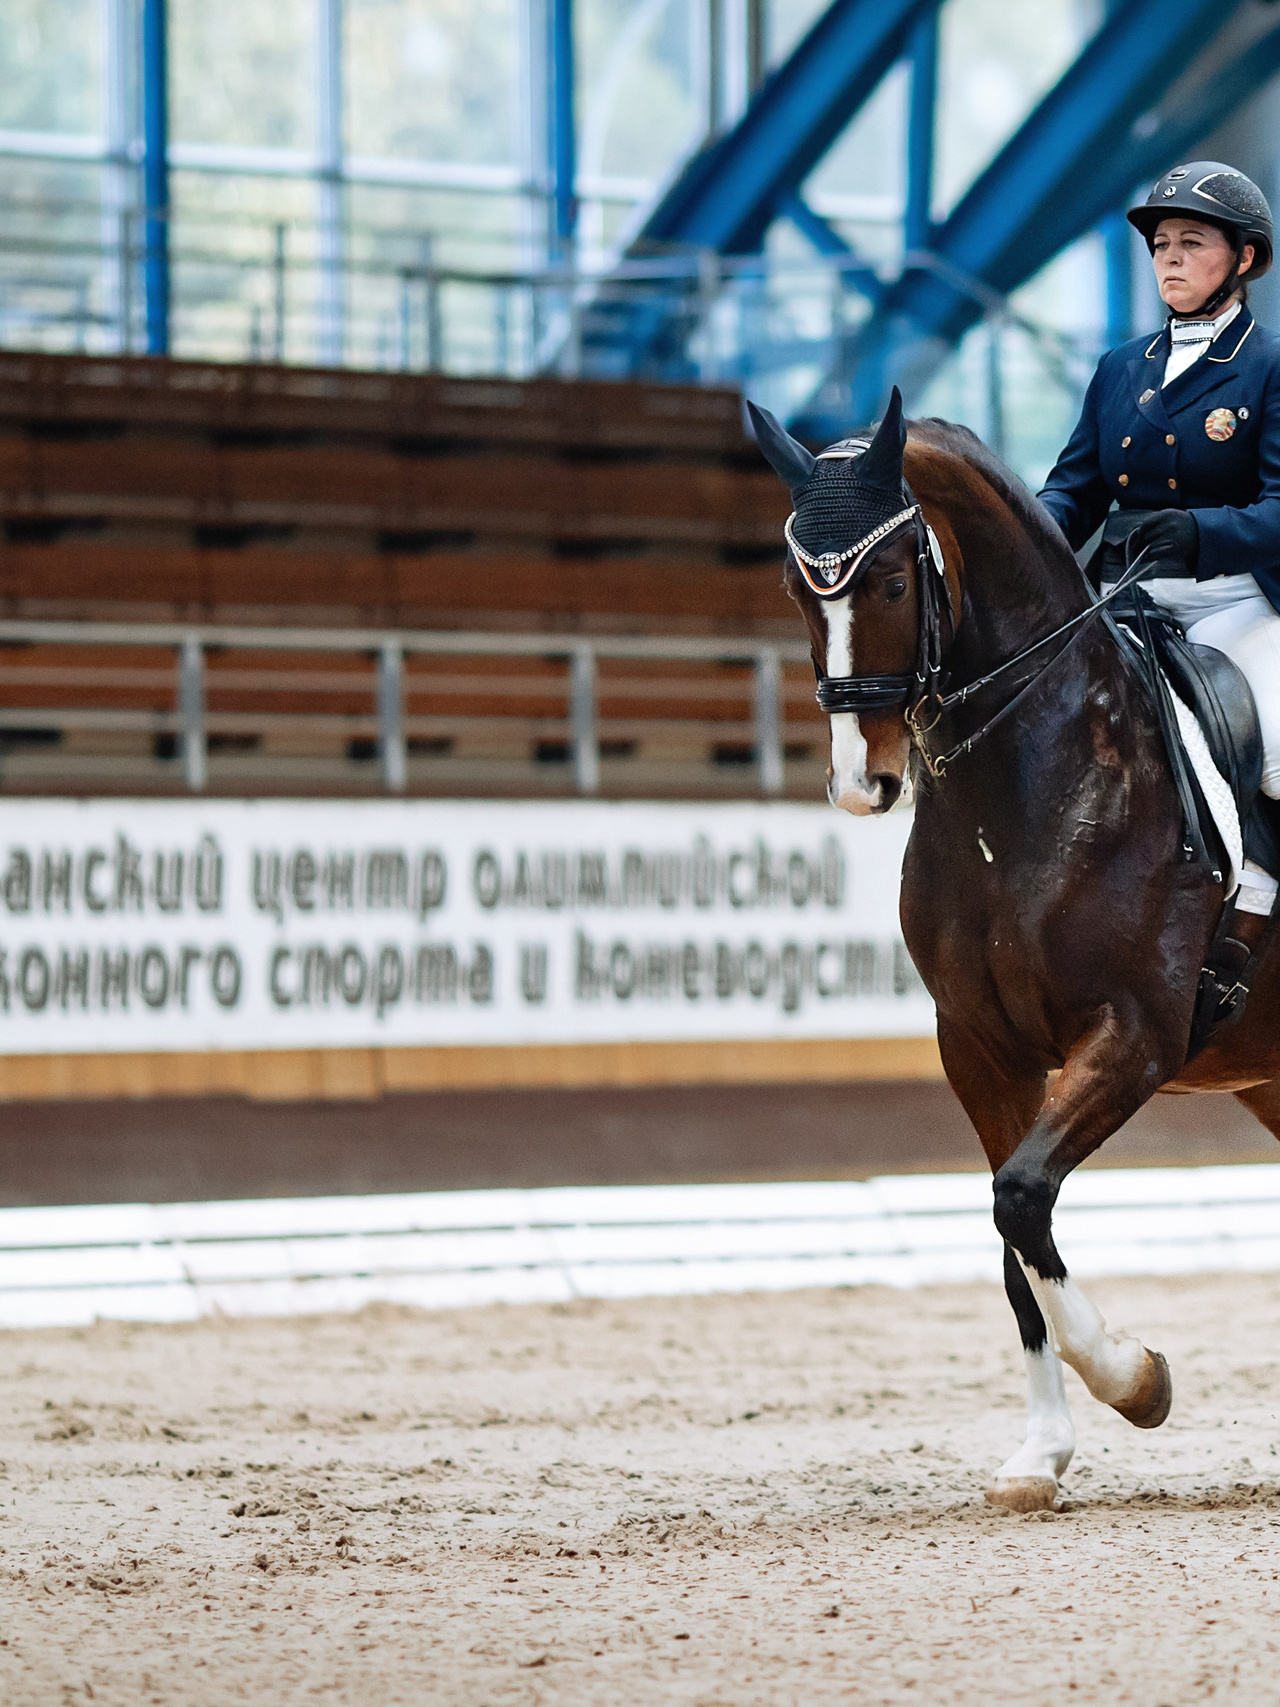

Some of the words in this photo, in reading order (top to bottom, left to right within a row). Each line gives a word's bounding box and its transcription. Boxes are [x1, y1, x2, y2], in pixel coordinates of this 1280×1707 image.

[251, 848, 447, 924] центр
[474, 832, 846, 912] олимпийской
[269, 941, 493, 1024] спорта
[519, 942, 547, 1003] и
[575, 928, 922, 1018] коневодств
